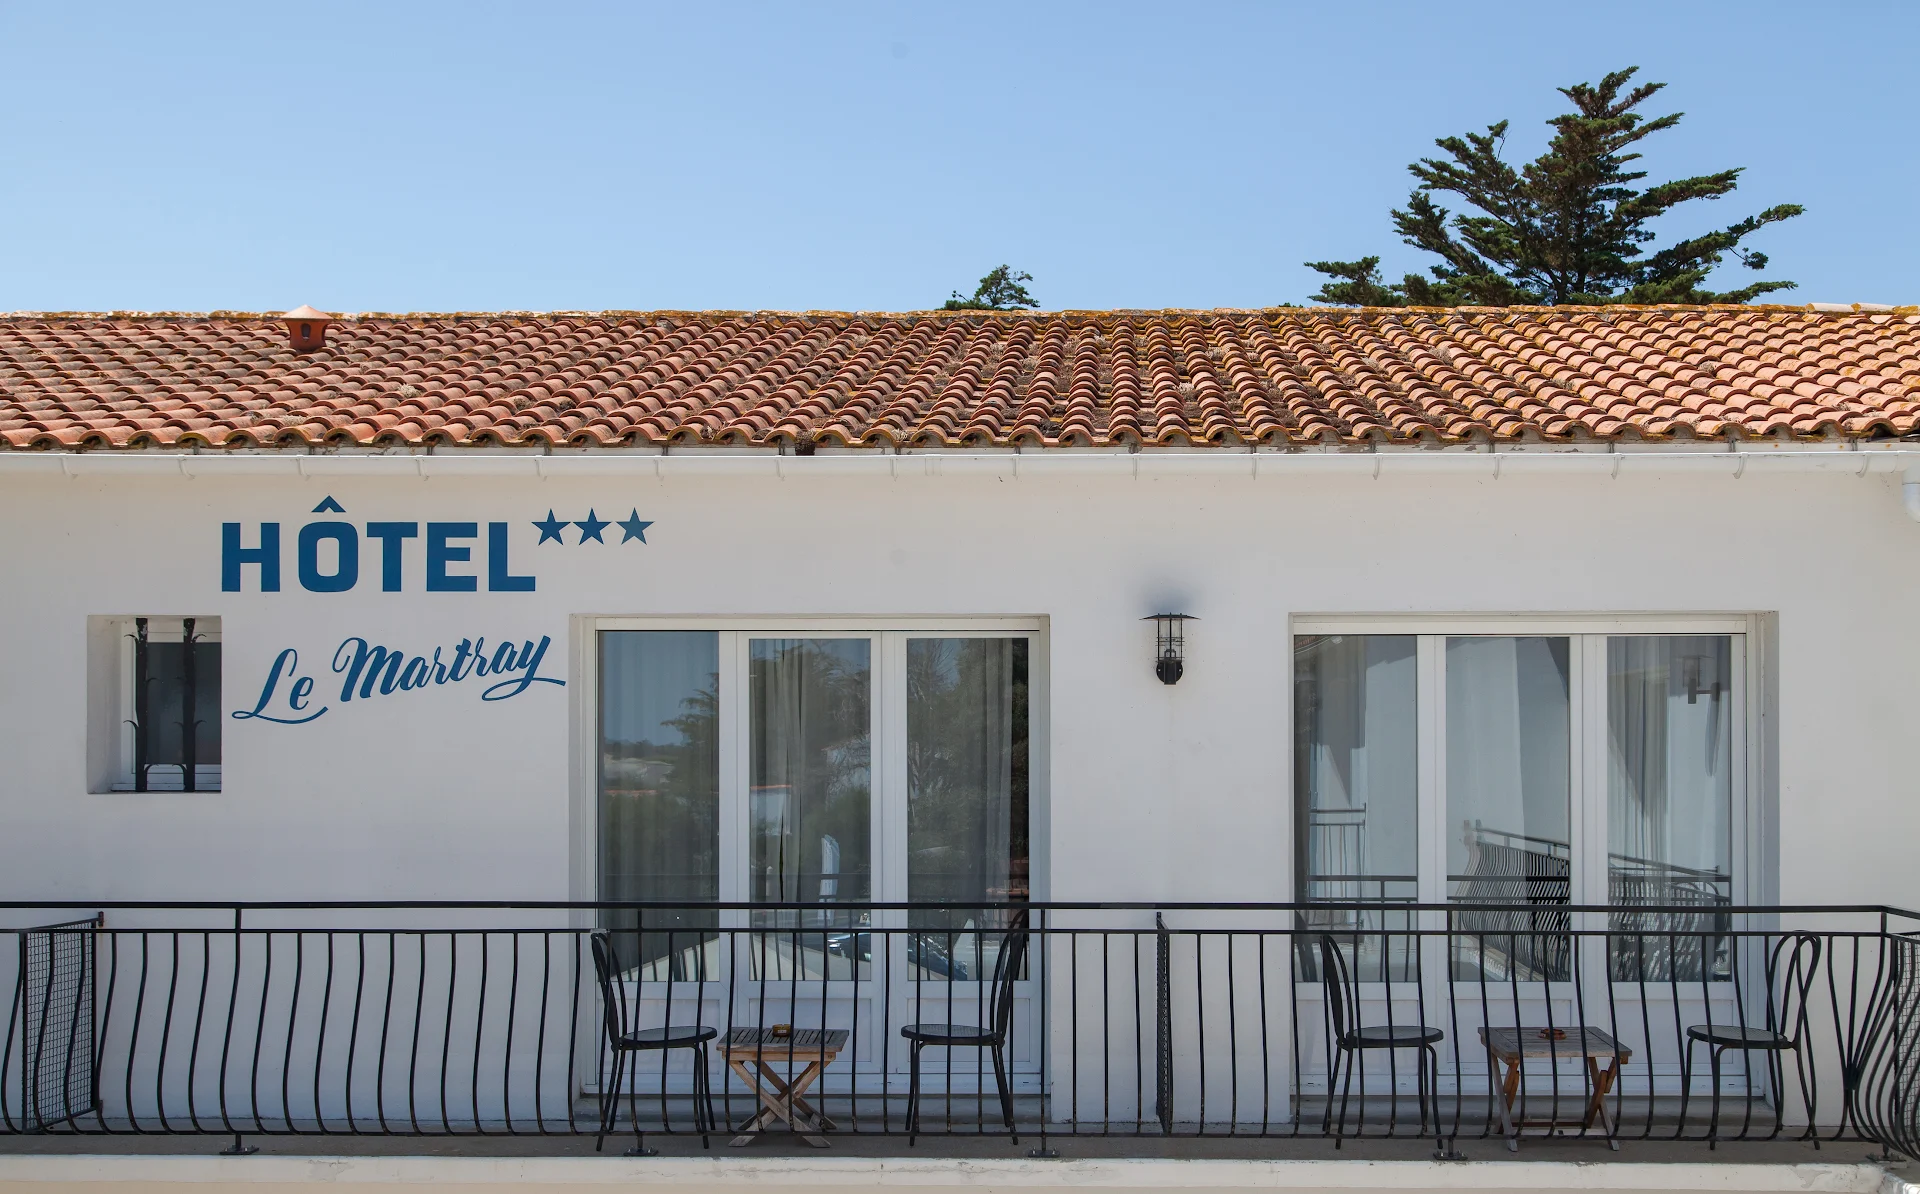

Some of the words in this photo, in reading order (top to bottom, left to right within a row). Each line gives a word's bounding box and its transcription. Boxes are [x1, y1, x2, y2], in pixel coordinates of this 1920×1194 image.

[221, 495, 536, 593] HÔTEL
[232, 648, 329, 725] Le
[332, 635, 567, 702] Martray
